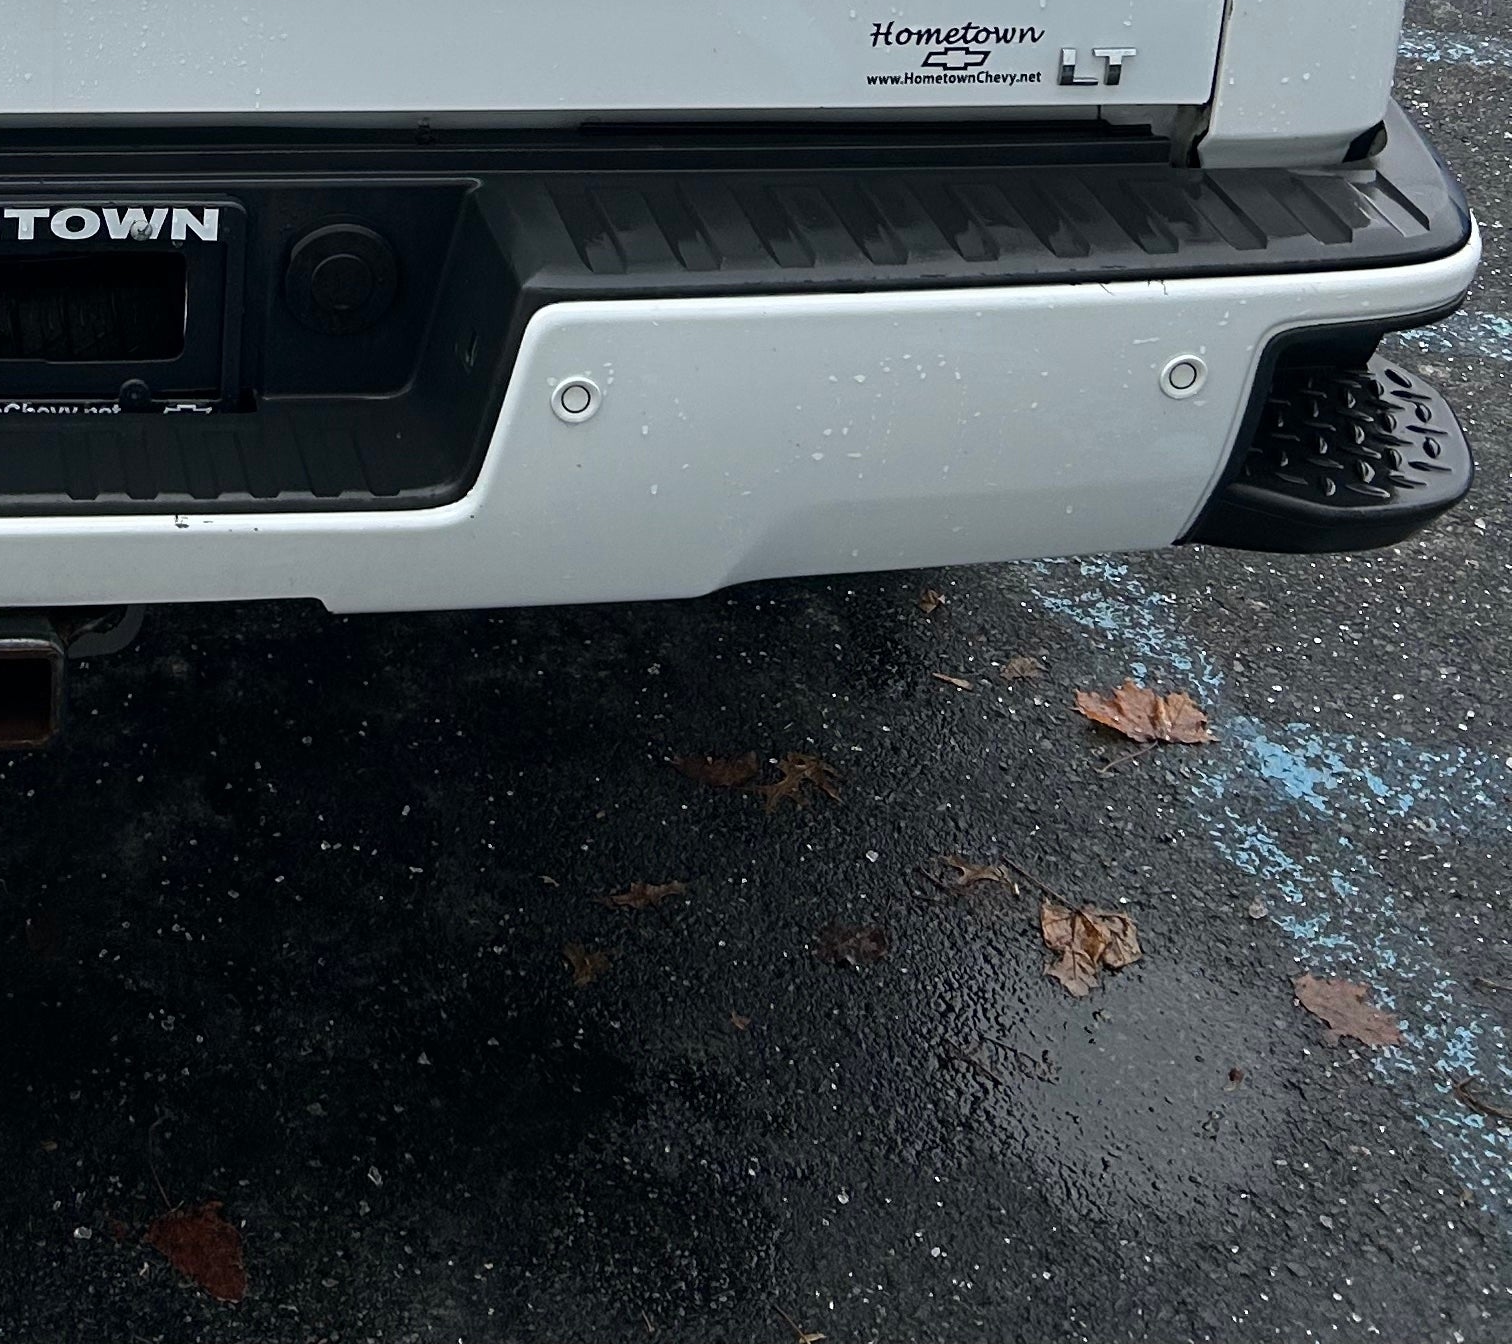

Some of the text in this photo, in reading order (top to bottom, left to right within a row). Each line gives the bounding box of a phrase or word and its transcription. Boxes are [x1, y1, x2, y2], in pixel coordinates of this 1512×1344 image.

[869, 20, 1045, 48] Hometown
[866, 70, 1042, 87] www.HometownChevy.net
[1057, 47, 1138, 86] LT
